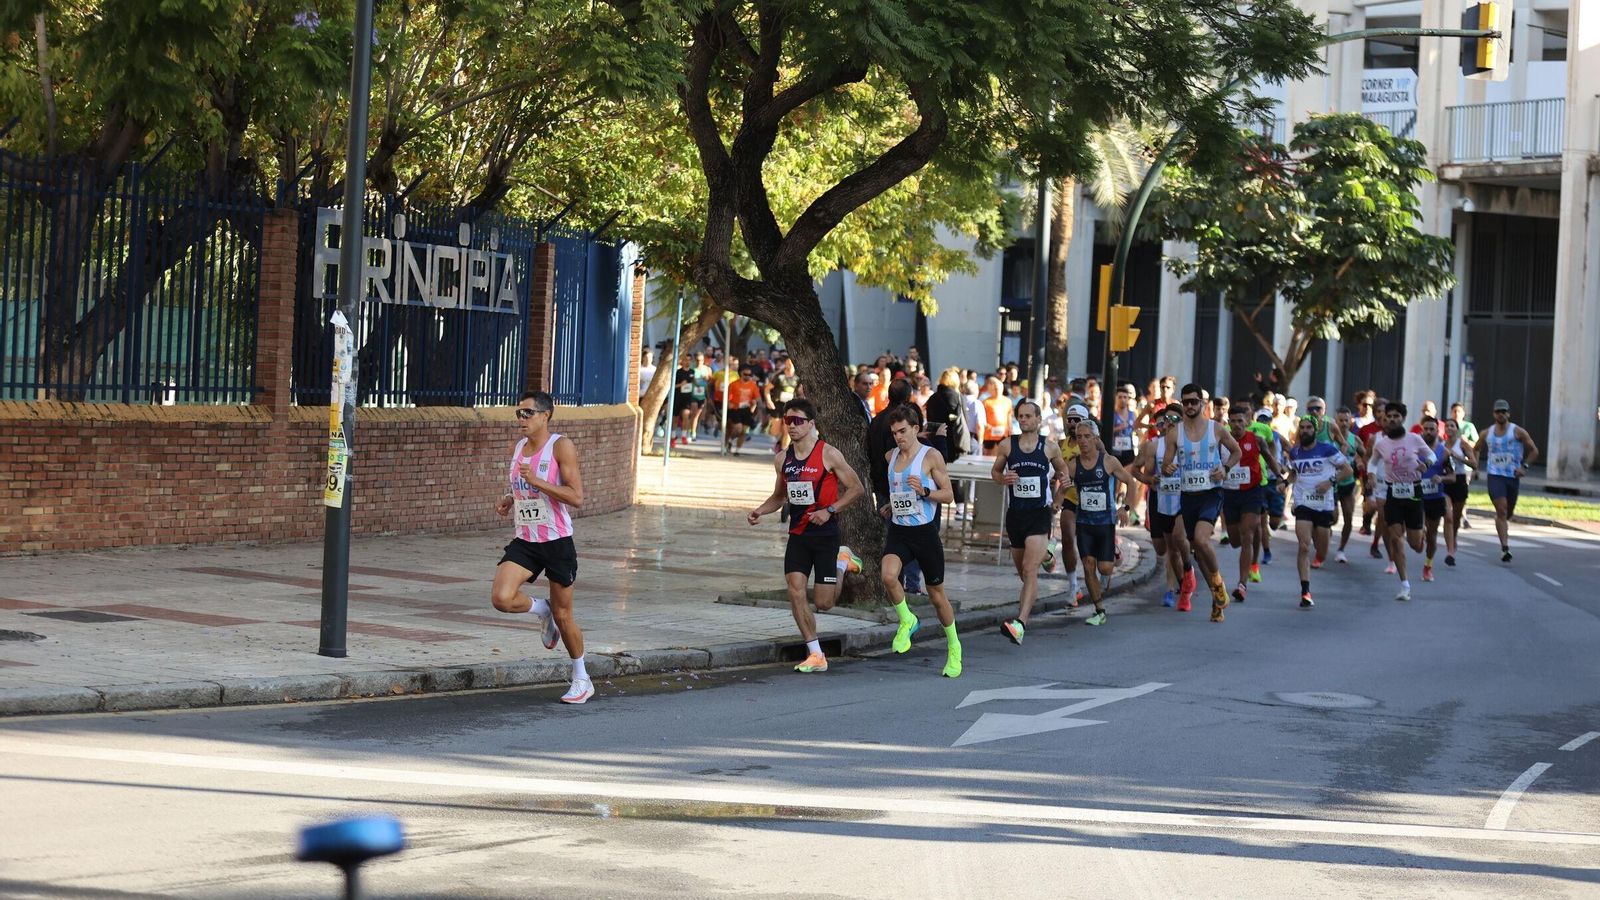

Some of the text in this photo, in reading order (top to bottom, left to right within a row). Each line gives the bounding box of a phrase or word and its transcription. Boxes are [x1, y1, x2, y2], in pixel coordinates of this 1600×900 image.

[1361, 78, 1410, 90] CORNER VIP
[325, 474, 339, 491] 9
[1017, 484, 1036, 492] 390
[790, 490, 808, 498] 694
[894, 500, 912, 509] 330
[519, 508, 539, 518] 117
